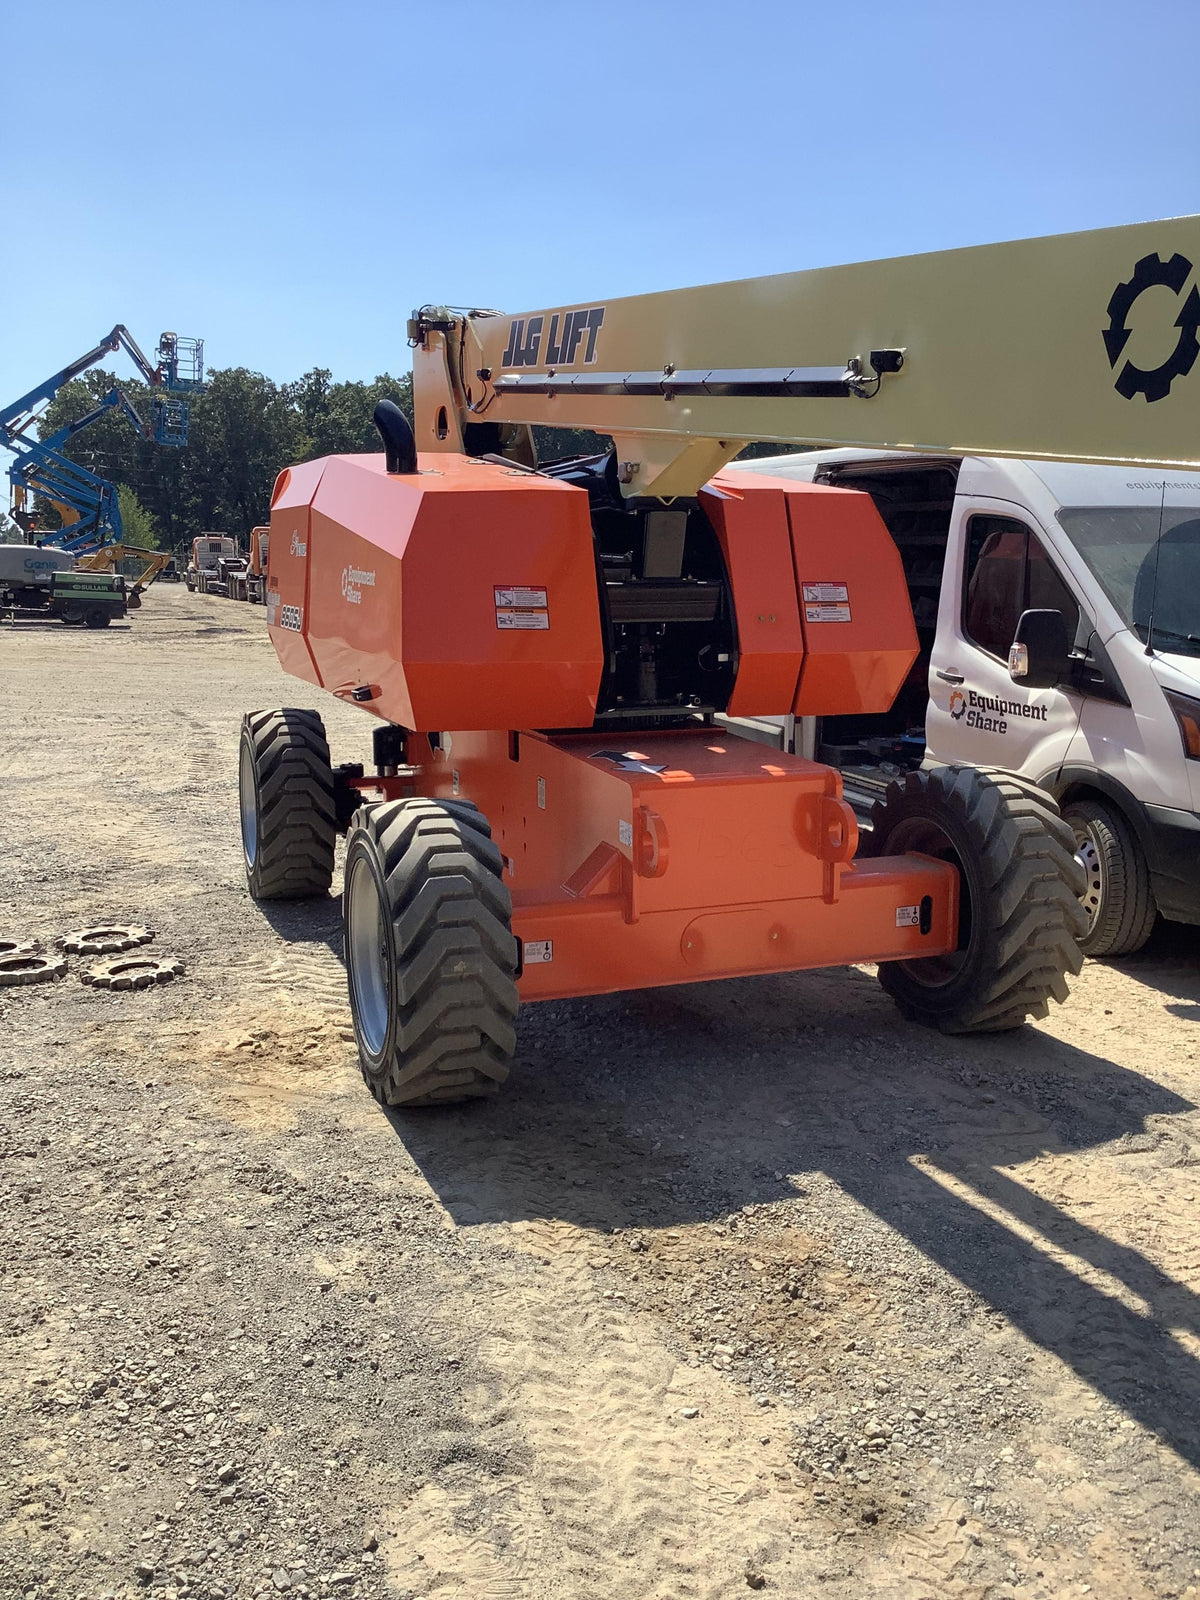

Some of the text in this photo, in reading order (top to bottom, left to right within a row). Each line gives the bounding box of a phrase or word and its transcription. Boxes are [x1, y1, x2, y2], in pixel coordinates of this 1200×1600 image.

[501, 306, 606, 368] JLG LIFT
[24, 558, 58, 570] Genie
[348, 565, 376, 587] Equipment
[968, 690, 1048, 721] Equipment
[966, 710, 1008, 734] Share
